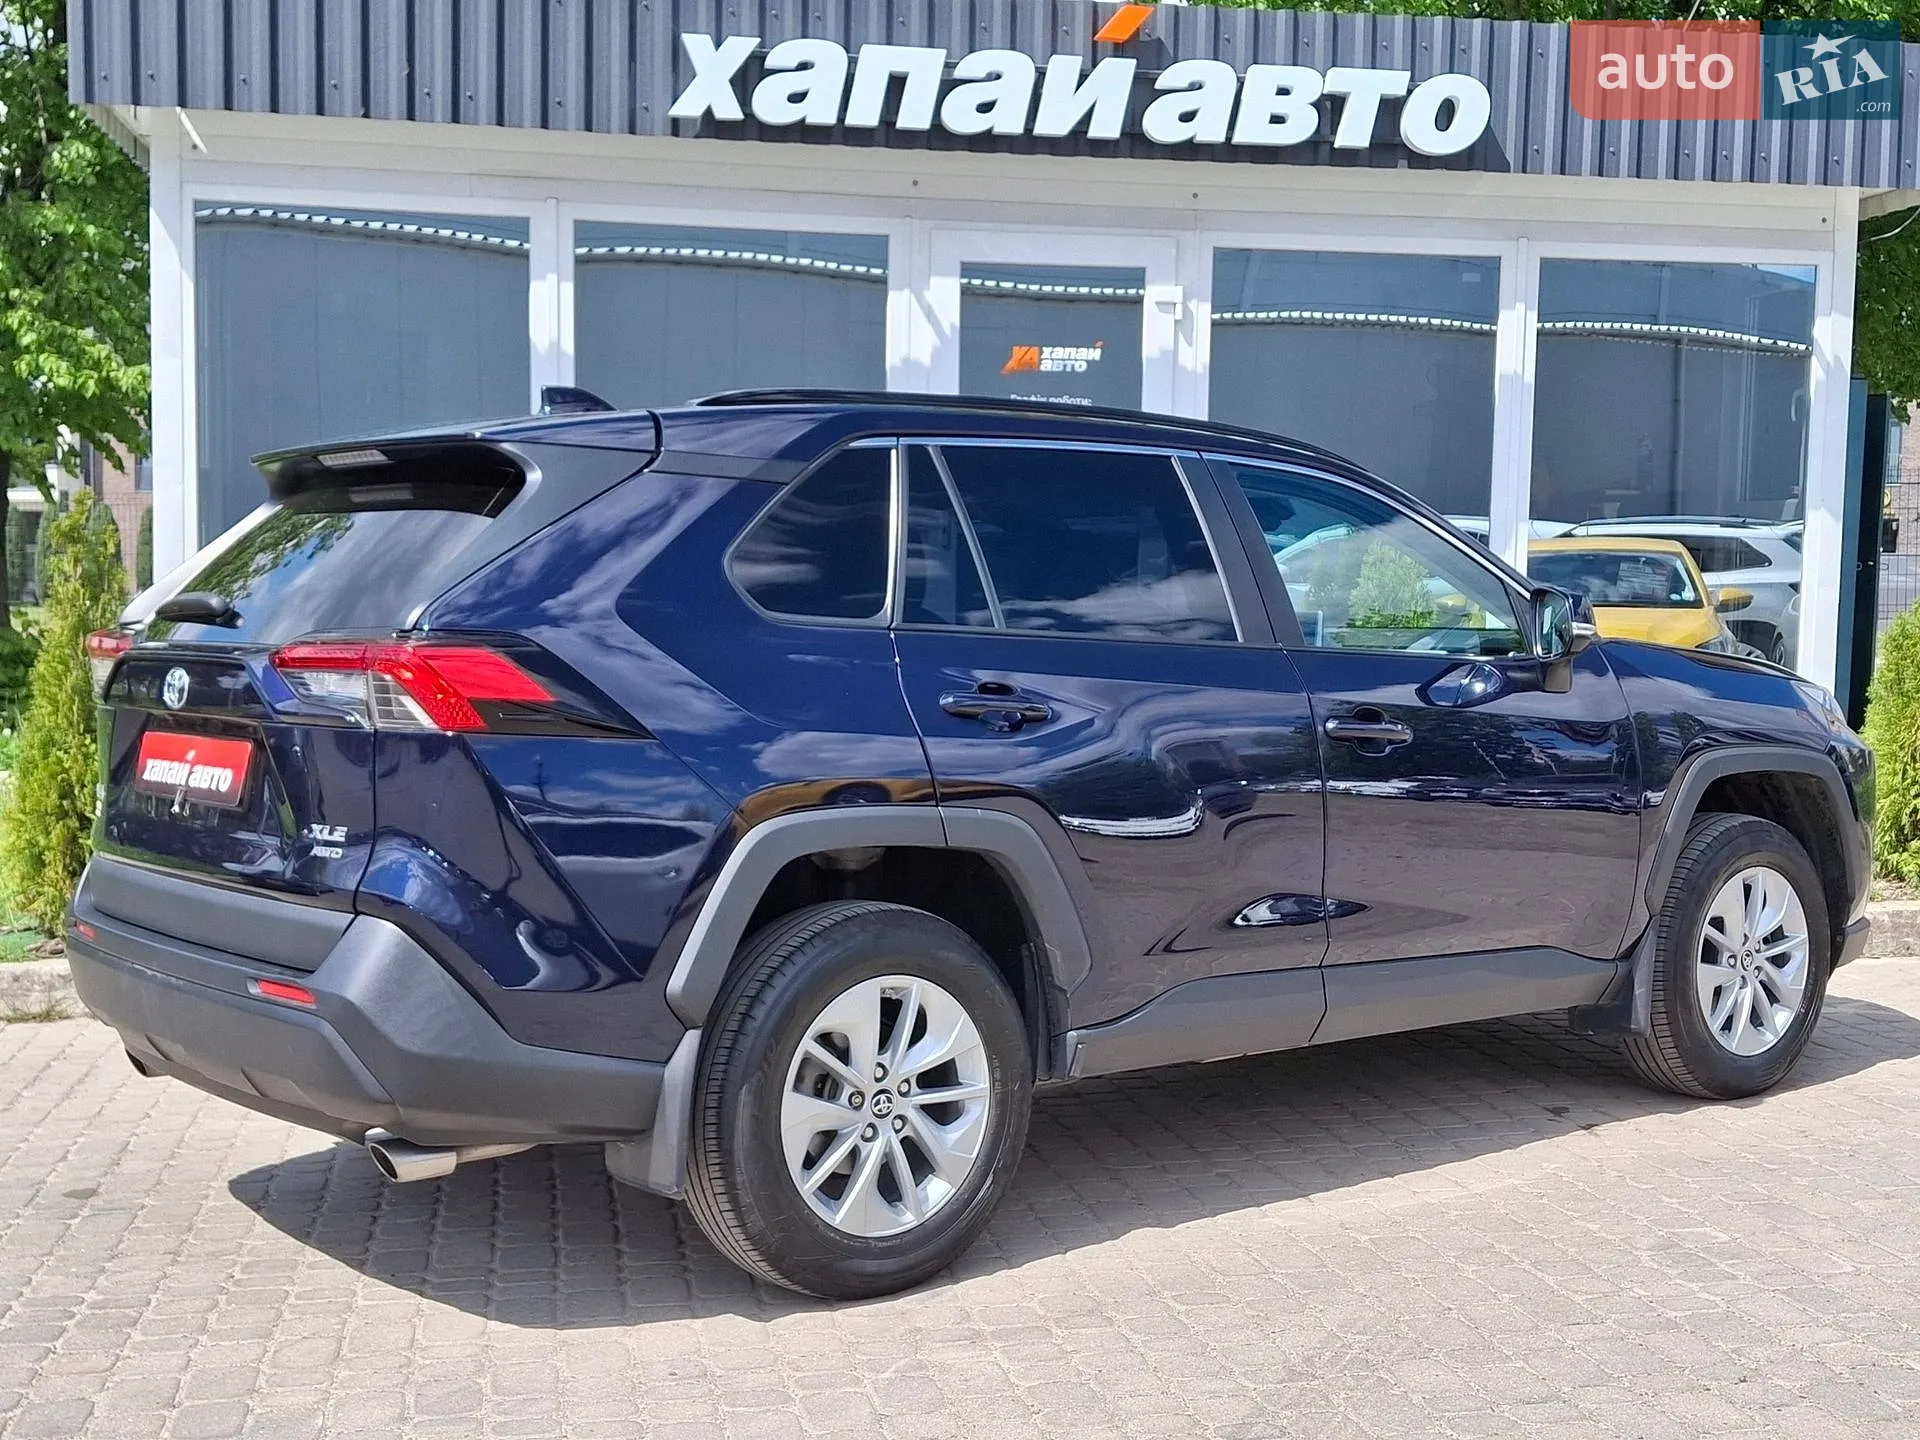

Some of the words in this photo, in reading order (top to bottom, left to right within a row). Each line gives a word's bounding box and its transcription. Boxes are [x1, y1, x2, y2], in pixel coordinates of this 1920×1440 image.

[668, 4, 1154, 140] хапай
[1142, 58, 1492, 157] авто
[1040, 341, 1104, 360] хапай
[1040, 360, 1088, 373] авто
[142, 749, 197, 786] хапай
[188, 764, 233, 793] авто
[308, 823, 348, 842] XLE
